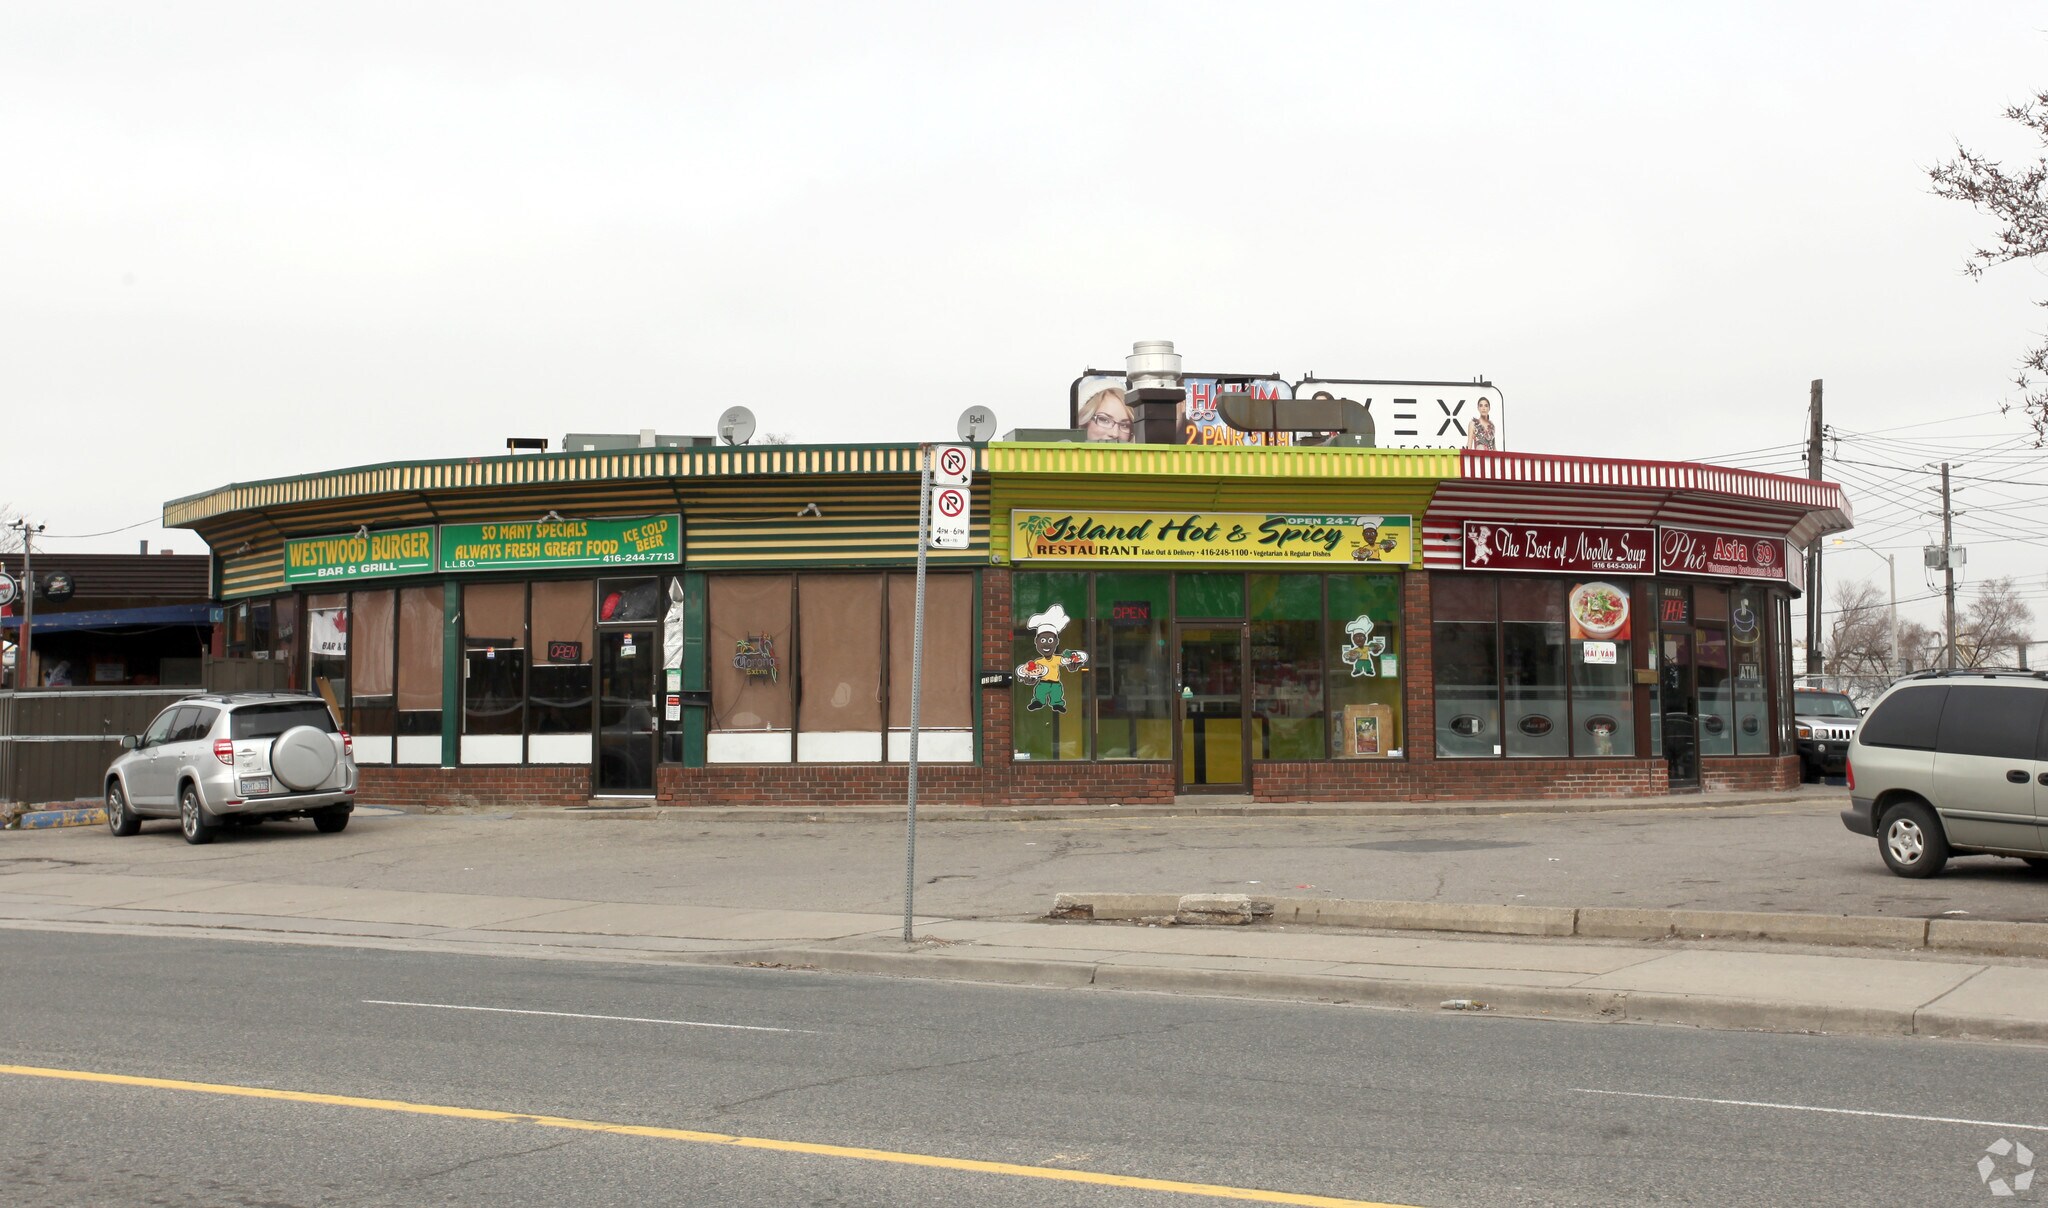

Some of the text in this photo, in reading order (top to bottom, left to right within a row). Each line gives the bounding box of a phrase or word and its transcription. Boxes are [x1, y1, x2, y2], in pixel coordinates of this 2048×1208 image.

[1192, 384, 1280, 410] HAIM
[970, 414, 985, 423] Bell
[1186, 424, 1198, 446] 2
[1202, 425, 1245, 446] PAIR
[1287, 517, 1356, 526] OPEN 24-7
[482, 522, 588, 540] SO MANY SPECIALS
[622, 519, 668, 544] ICE COLD
[937, 527, 949, 535] 4PM
[953, 527, 965, 535] 6PM
[1043, 514, 1344, 551] Island Hot & Spicy
[289, 532, 430, 567] WESTWOOD BURGER
[455, 540, 619, 560] ALWAYS FRESH GREAT FOOD
[635, 534, 664, 552] BEER
[1496, 527, 1646, 568] The Best of Noodle Soup
[1713, 536, 1748, 562] Asia
[1757, 544, 1773, 562] 39
[1037, 545, 1140, 556] RESTAURANT
[603, 553, 675, 563] 416-244-7713
[318, 563, 397, 577] BAR & GRILL
[1113, 607, 1148, 618] OPEN
[322, 642, 336, 650] BAR
[550, 645, 577, 658] OPEN
[733, 656, 775, 669] Corona
[1740, 666, 1758, 679] ATM
